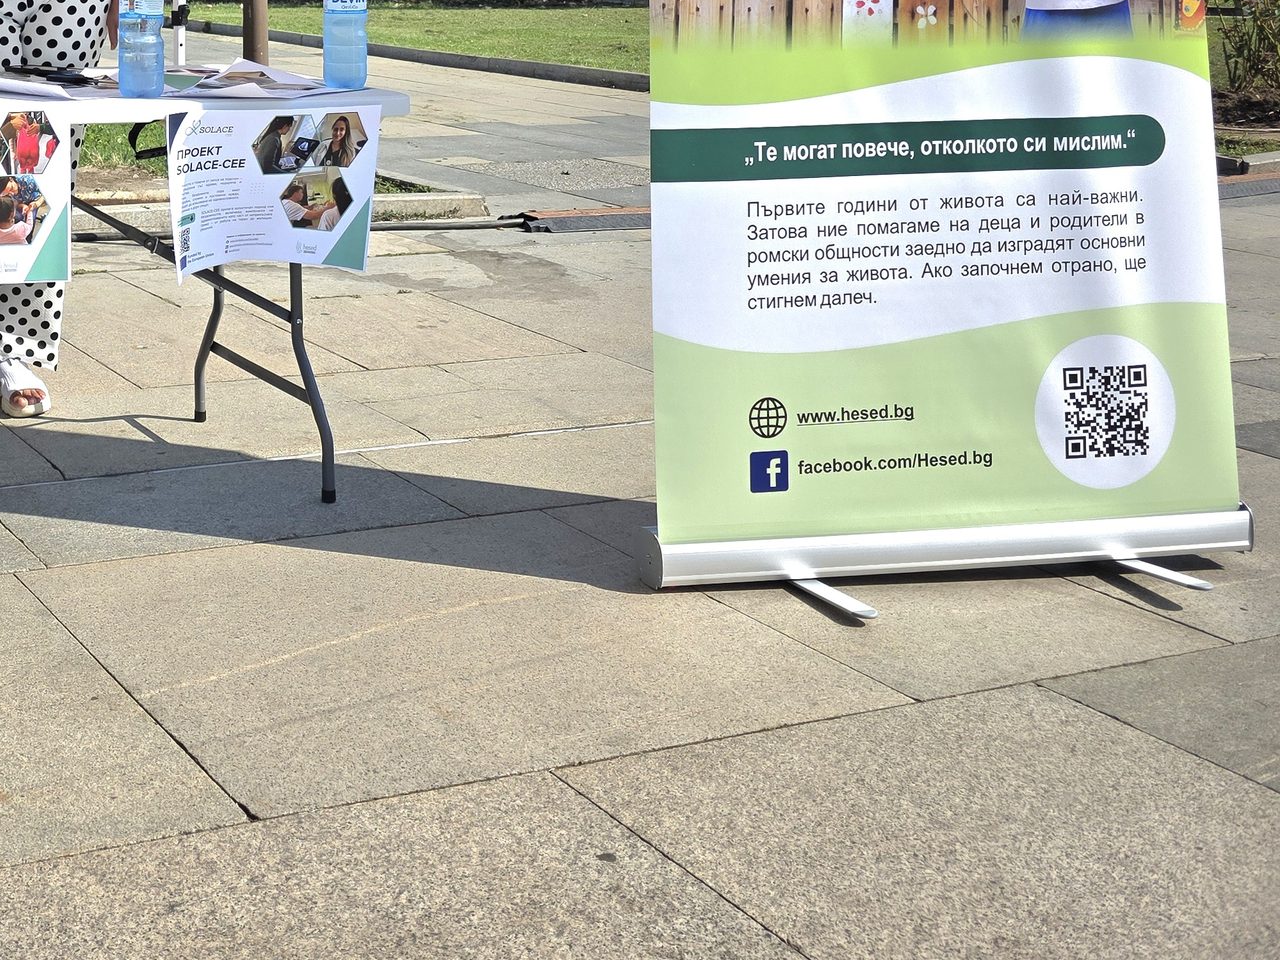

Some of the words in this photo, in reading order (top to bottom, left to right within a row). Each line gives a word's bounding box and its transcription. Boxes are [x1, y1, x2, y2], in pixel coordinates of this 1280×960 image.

[199, 125, 234, 134] SOLACE
[177, 145, 223, 161] ПРОЕКТ
[783, 142, 837, 161] могат
[841, 141, 915, 159] повече,
[920, 136, 1018, 156] отколкото
[1023, 136, 1047, 152] си
[176, 158, 246, 176] SOLACE-CEE
[747, 201, 826, 220] Първите
[837, 198, 898, 215] години
[909, 197, 929, 211] от
[939, 194, 1005, 210] живота
[1016, 193, 1036, 207] са
[1048, 189, 1144, 206] най-важни.
[747, 224, 808, 241] Затова
[817, 223, 848, 238] ние
[856, 220, 940, 236] помагаме
[949, 218, 970, 232] на
[978, 217, 1021, 233] деца
[1030, 216, 1041, 229] и
[1050, 212, 1128, 232] родители
[1135, 212, 1145, 225] в
[747, 248, 810, 268] ромски
[814, 243, 900, 264] общности
[905, 241, 966, 259] заедно
[970, 241, 992, 257] да
[997, 237, 1075, 256] изградят
[1080, 235, 1146, 251] основни
[747, 271, 812, 291] умения
[819, 270, 839, 283] за
[846, 266, 913, 283] живота.
[921, 262, 953, 279] Ако
[960, 260, 1043, 277] започнем
[1051, 258, 1118, 276] отрано,
[1124, 256, 1147, 272] ще
[747, 294, 817, 311] стигнем
[820, 292, 878, 309] далеч.
[796, 403, 915, 425] www.hesed.bg
[797, 450, 993, 475] facebook.com/Hesed.bg
